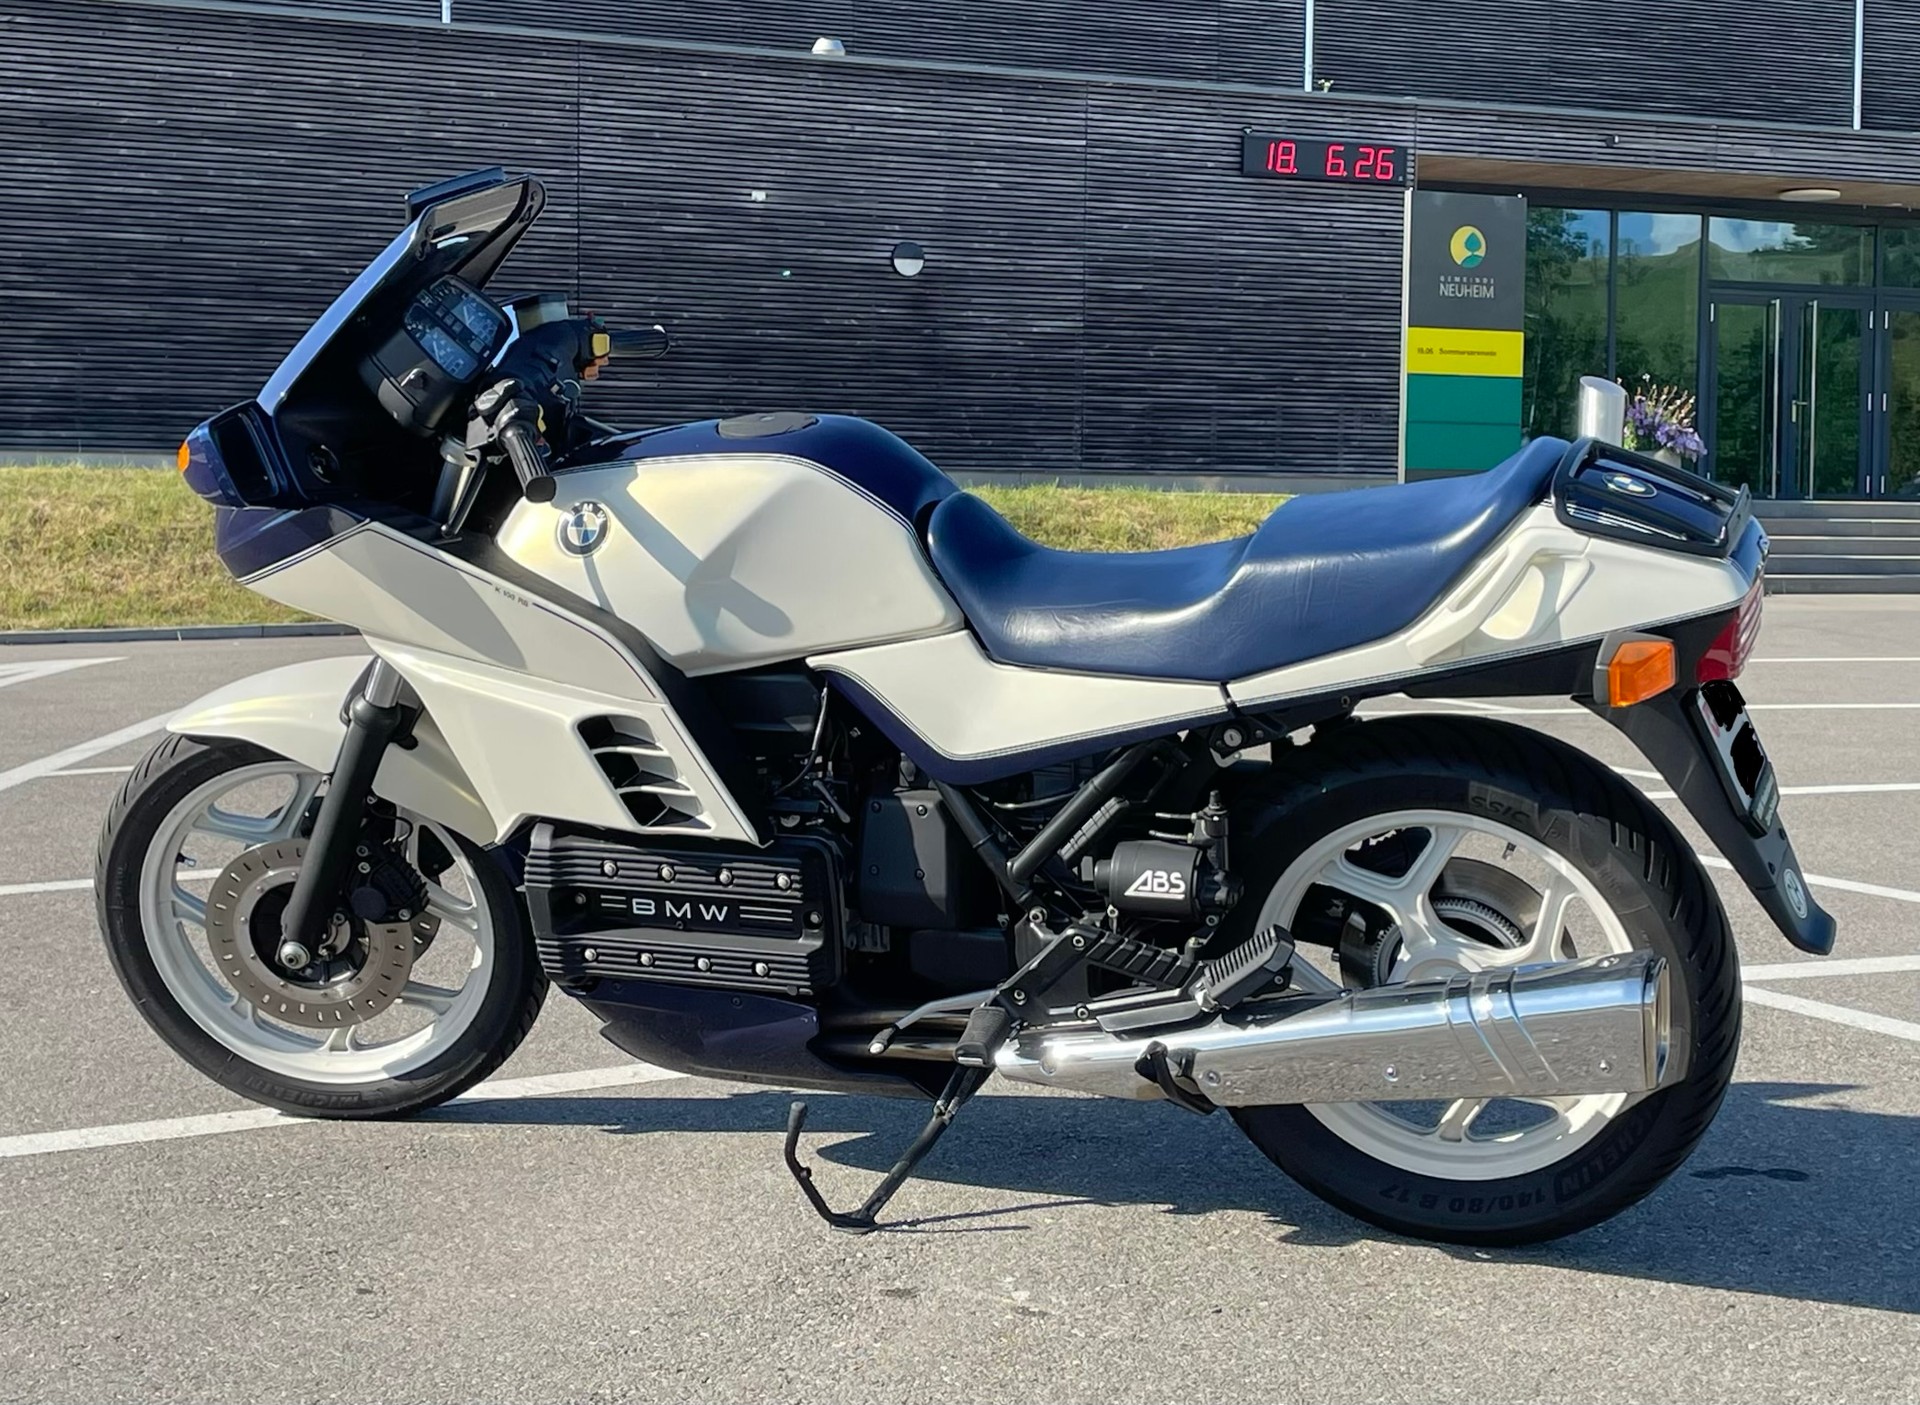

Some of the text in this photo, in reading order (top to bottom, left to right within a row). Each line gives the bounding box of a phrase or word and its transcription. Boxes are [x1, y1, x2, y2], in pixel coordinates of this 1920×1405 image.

[1267, 141, 1298, 174] 18.
[1439, 283, 1495, 299] NEUHEIM
[1124, 870, 1186, 899] ABS
[632, 898, 728, 922] BMW
